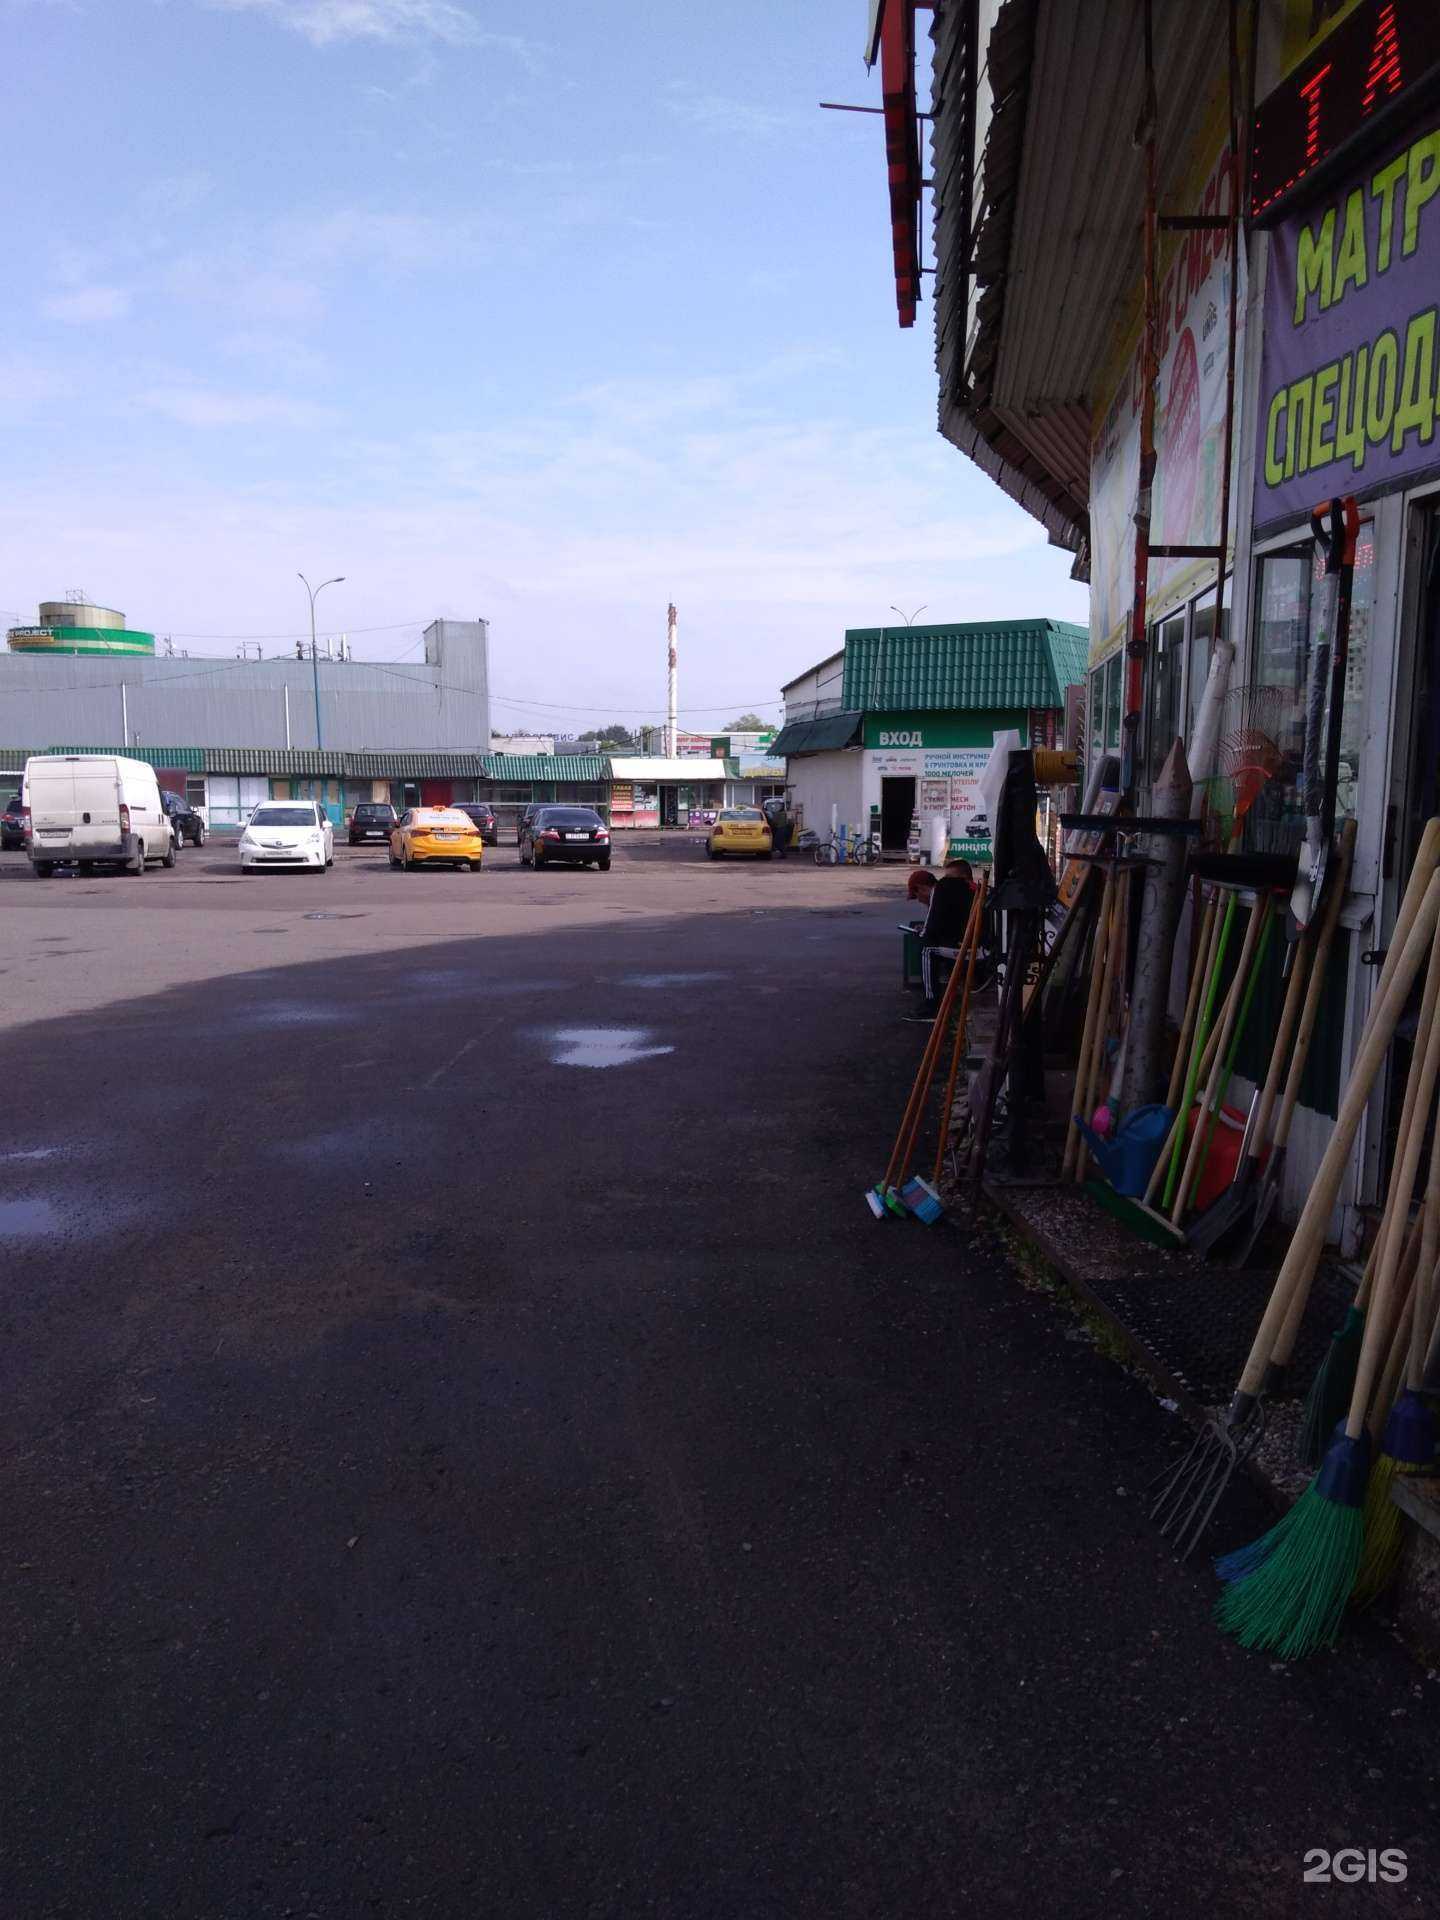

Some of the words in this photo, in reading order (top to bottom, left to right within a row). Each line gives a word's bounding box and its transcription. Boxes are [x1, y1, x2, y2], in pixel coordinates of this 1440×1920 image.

[1264, 305, 1440, 489] СПЕЦОД
[879, 731, 923, 747] ВХОД
[925, 770, 940, 778] 1000
[942, 769, 974, 778] МЕЛОЧЕЙ
